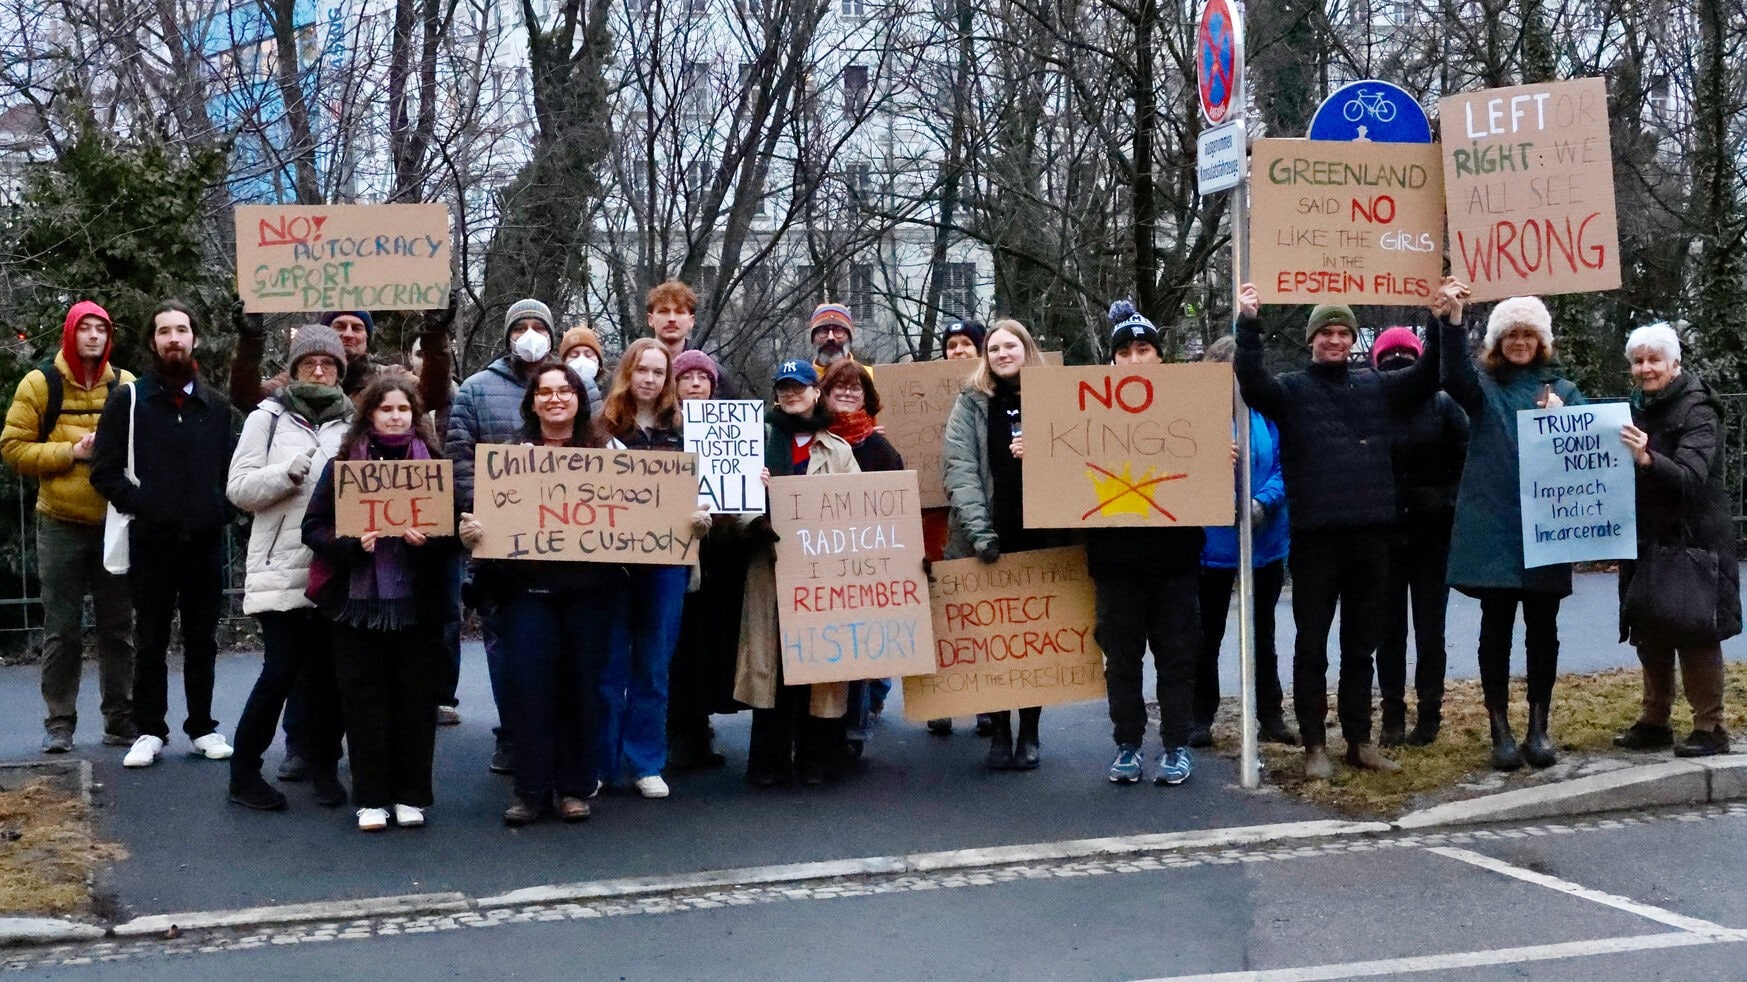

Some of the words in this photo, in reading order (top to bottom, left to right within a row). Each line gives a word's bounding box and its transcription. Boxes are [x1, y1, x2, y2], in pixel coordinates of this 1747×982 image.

[1465, 92, 1550, 138] LEFT
[1556, 90, 1597, 129] OR
[1555, 138, 1596, 165] WE
[1269, 158, 1428, 189] GREENLAND
[1469, 182, 1516, 214] ALL
[1530, 173, 1585, 209] SEE
[1296, 197, 1340, 215] SAID
[1351, 195, 1396, 224] NO
[294, 235, 443, 262] AUTOCRACY
[1336, 230, 1373, 248] THE
[1457, 212, 1605, 283] WRONG
[1340, 256, 1365, 268] THE
[255, 262, 355, 291] SUPPORT
[301, 282, 449, 309] DEMOCRACY
[1078, 375, 1154, 414] NO
[687, 402, 763, 424] LIBERTY
[1533, 412, 1595, 435] TRUMP
[705, 425, 741, 440] AND
[1049, 419, 1198, 458] KINGS
[1552, 434, 1600, 455] BONDI
[690, 440, 759, 458] JUSTICE
[1564, 451, 1618, 472] NOEM:
[487, 449, 604, 480] Children
[711, 458, 742, 474] FOR
[338, 463, 444, 499] ABOLISH
[491, 488, 523, 509] be
[540, 480, 567, 502] in
[698, 474, 763, 511] ALL
[1533, 479, 1607, 503] Impeach
[358, 497, 439, 532] ICE
[538, 502, 630, 529] NOT
[789, 493, 804, 521] I
[820, 491, 853, 520] AM
[862, 489, 910, 517] NOT
[1551, 500, 1604, 519] Indict
[507, 530, 566, 558] ICE
[796, 525, 906, 556] RADICAL
[1535, 520, 1622, 543] Incarcerate
[809, 561, 822, 579] I
[838, 557, 891, 578] JUST
[1040, 560, 1080, 584] HAVE
[793, 580, 921, 611] REMEMBER
[945, 595, 1058, 632] PROTECT
[782, 618, 918, 664] HISTORY
[937, 626, 1090, 668] DEMOCRACY
[918, 672, 980, 696] FROM
